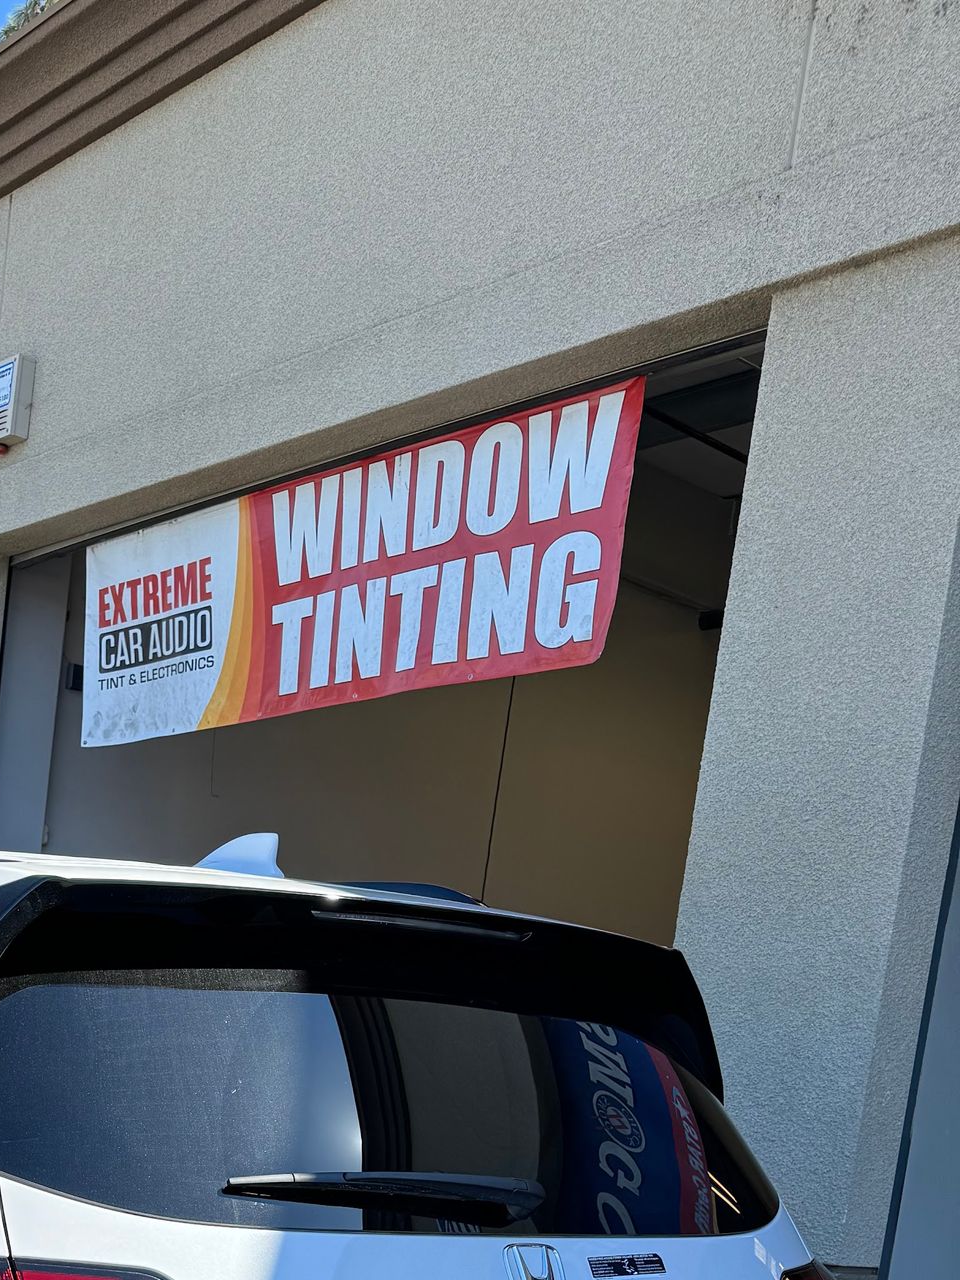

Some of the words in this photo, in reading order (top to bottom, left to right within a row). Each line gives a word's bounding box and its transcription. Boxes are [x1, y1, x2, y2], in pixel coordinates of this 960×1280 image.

[272, 391, 627, 586] WINDOW
[98, 556, 213, 628] EXTREME
[271, 530, 602, 696] TINTING
[98, 675, 125, 691] TINT
[128, 673, 137, 686] &
[140, 655, 215, 684] ELECTRONICS
[101, 628, 143, 670] CAR
[148, 609, 211, 660] AUDIO
